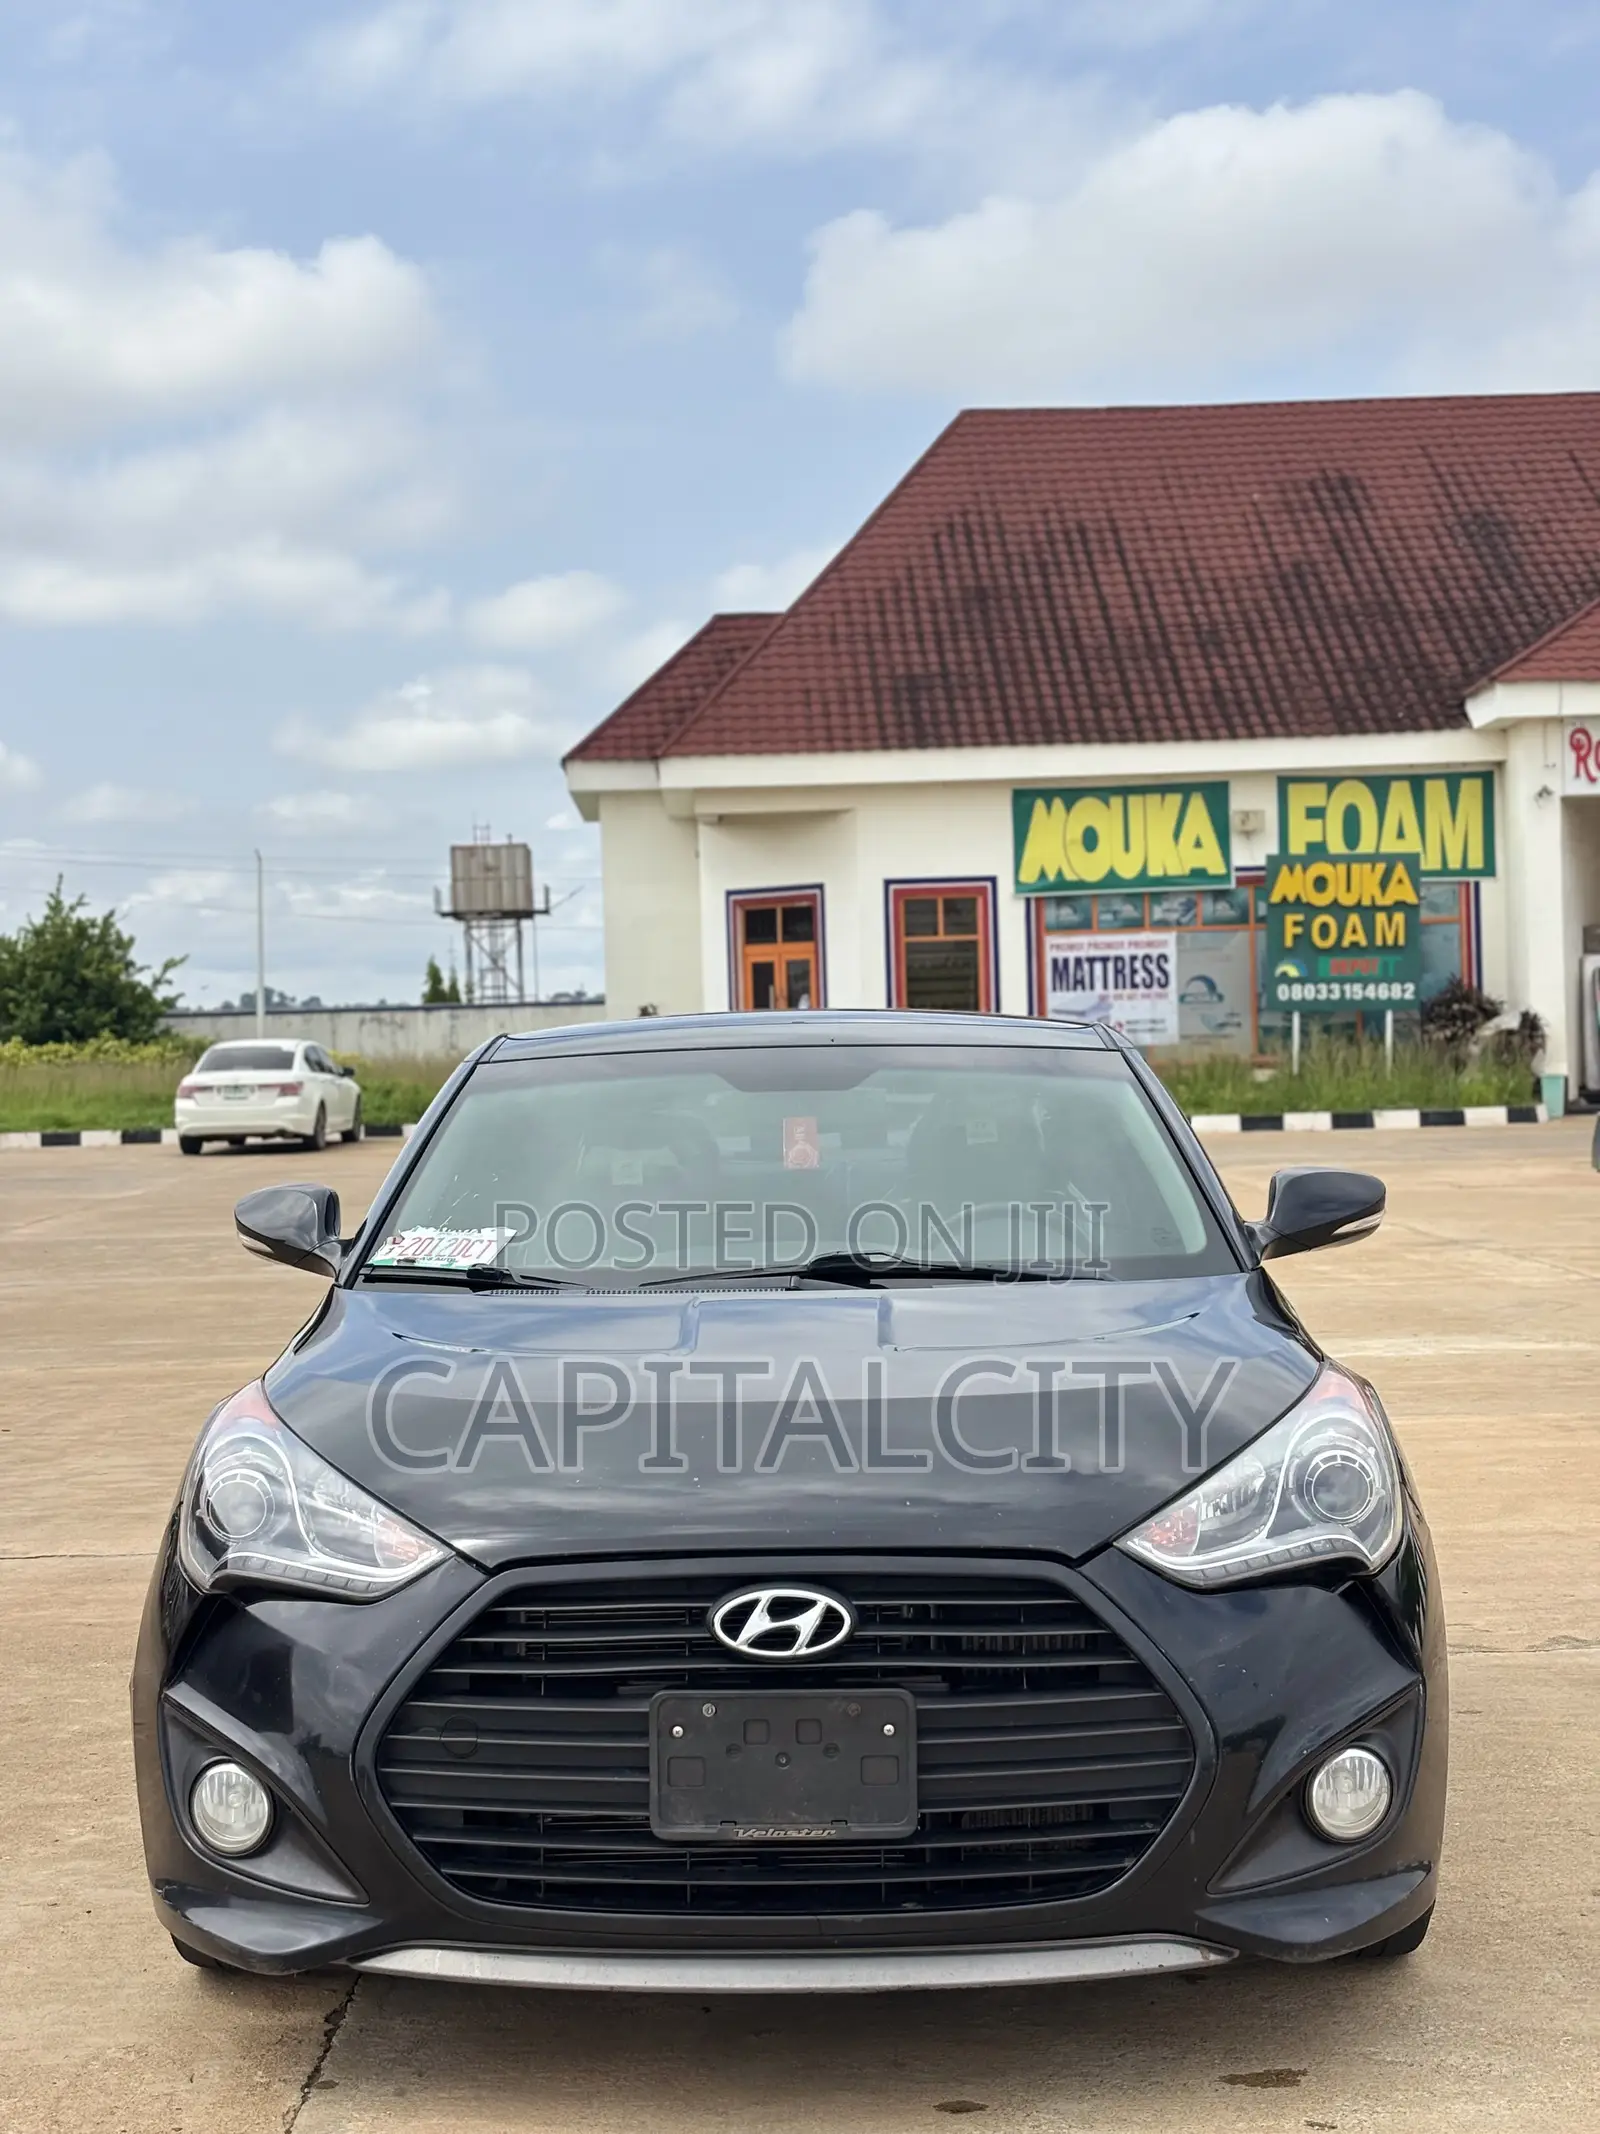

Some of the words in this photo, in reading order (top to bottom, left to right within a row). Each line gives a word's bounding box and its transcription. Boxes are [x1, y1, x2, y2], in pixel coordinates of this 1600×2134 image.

[1018, 791, 1228, 883] MOUKA
[1287, 778, 1485, 871] FOAM
[1268, 860, 1420, 907] MOUKA
[1283, 911, 1406, 949] FOAM
[1051, 953, 1170, 992] MATTRESS
[1276, 982, 1416, 1001] 08033154682
[733, 1828, 837, 1839] Veloster
